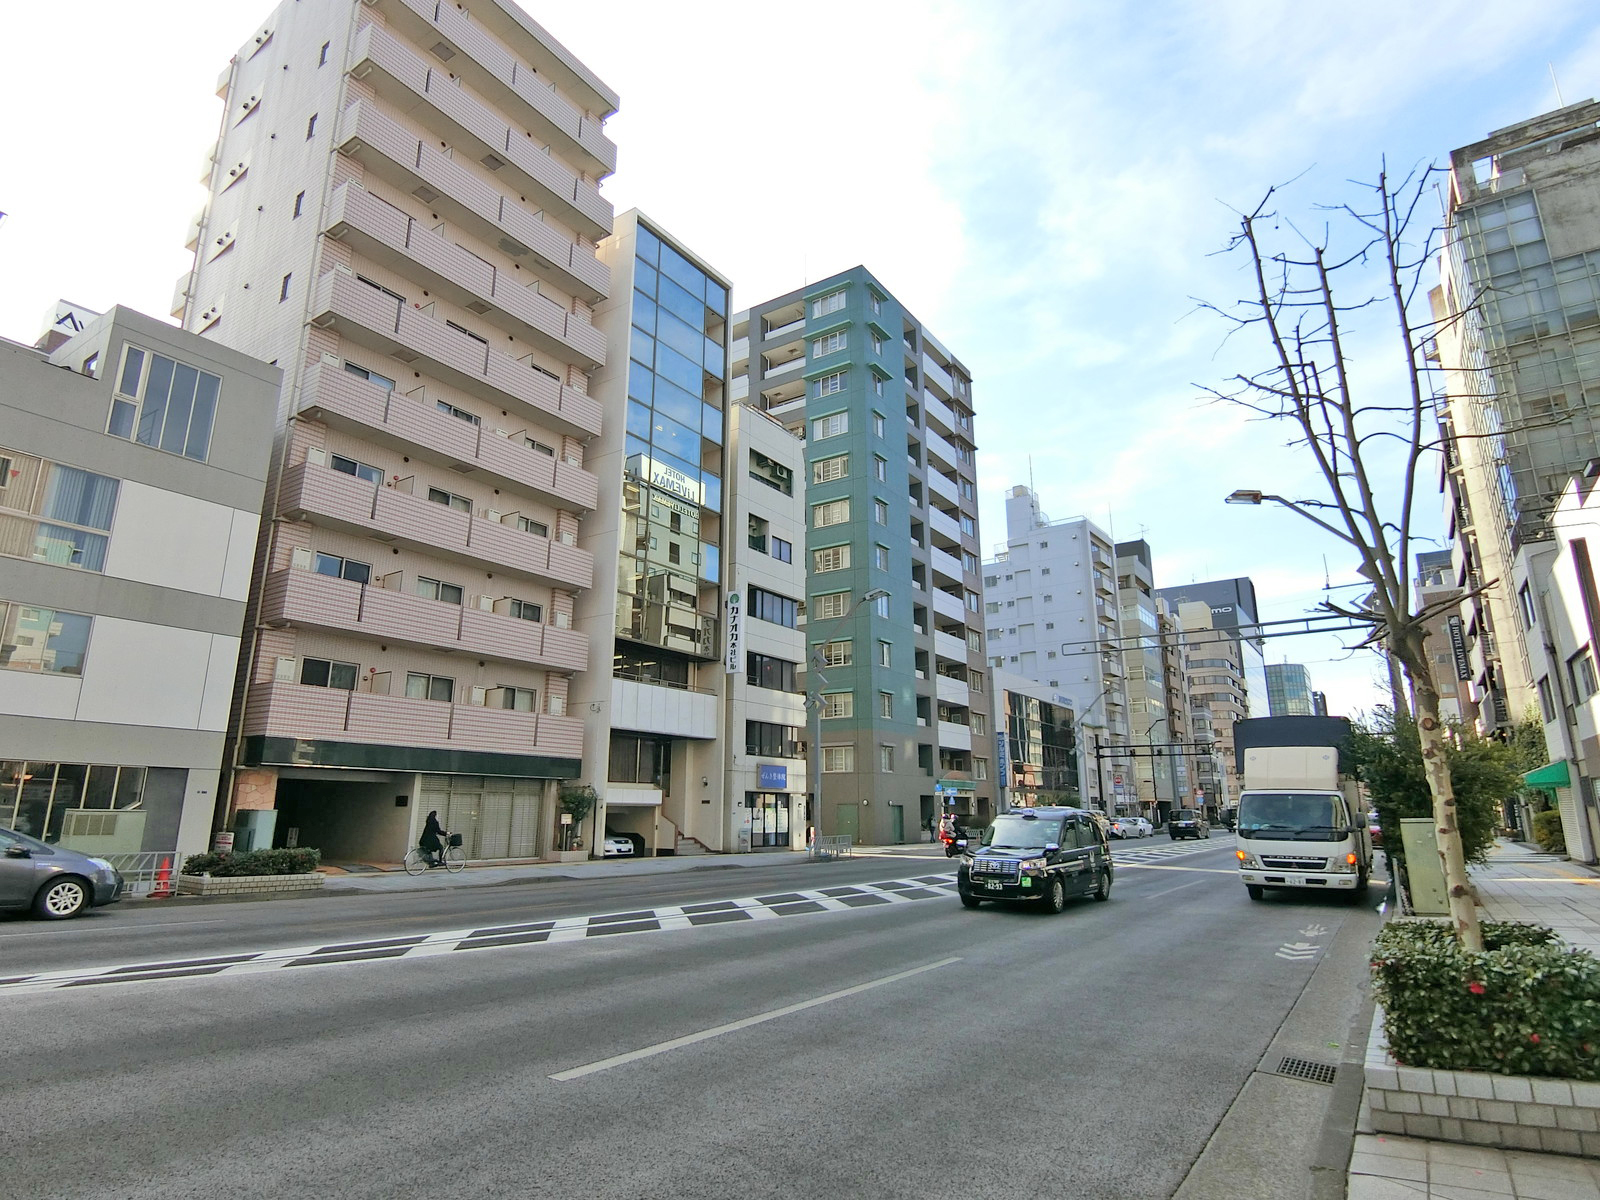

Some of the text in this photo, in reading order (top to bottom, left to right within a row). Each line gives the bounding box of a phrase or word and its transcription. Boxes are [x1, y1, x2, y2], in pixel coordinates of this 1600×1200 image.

[729, 606, 739, 670] カナオカ本社ビル
[1451, 626, 1462, 648] HOTEL
